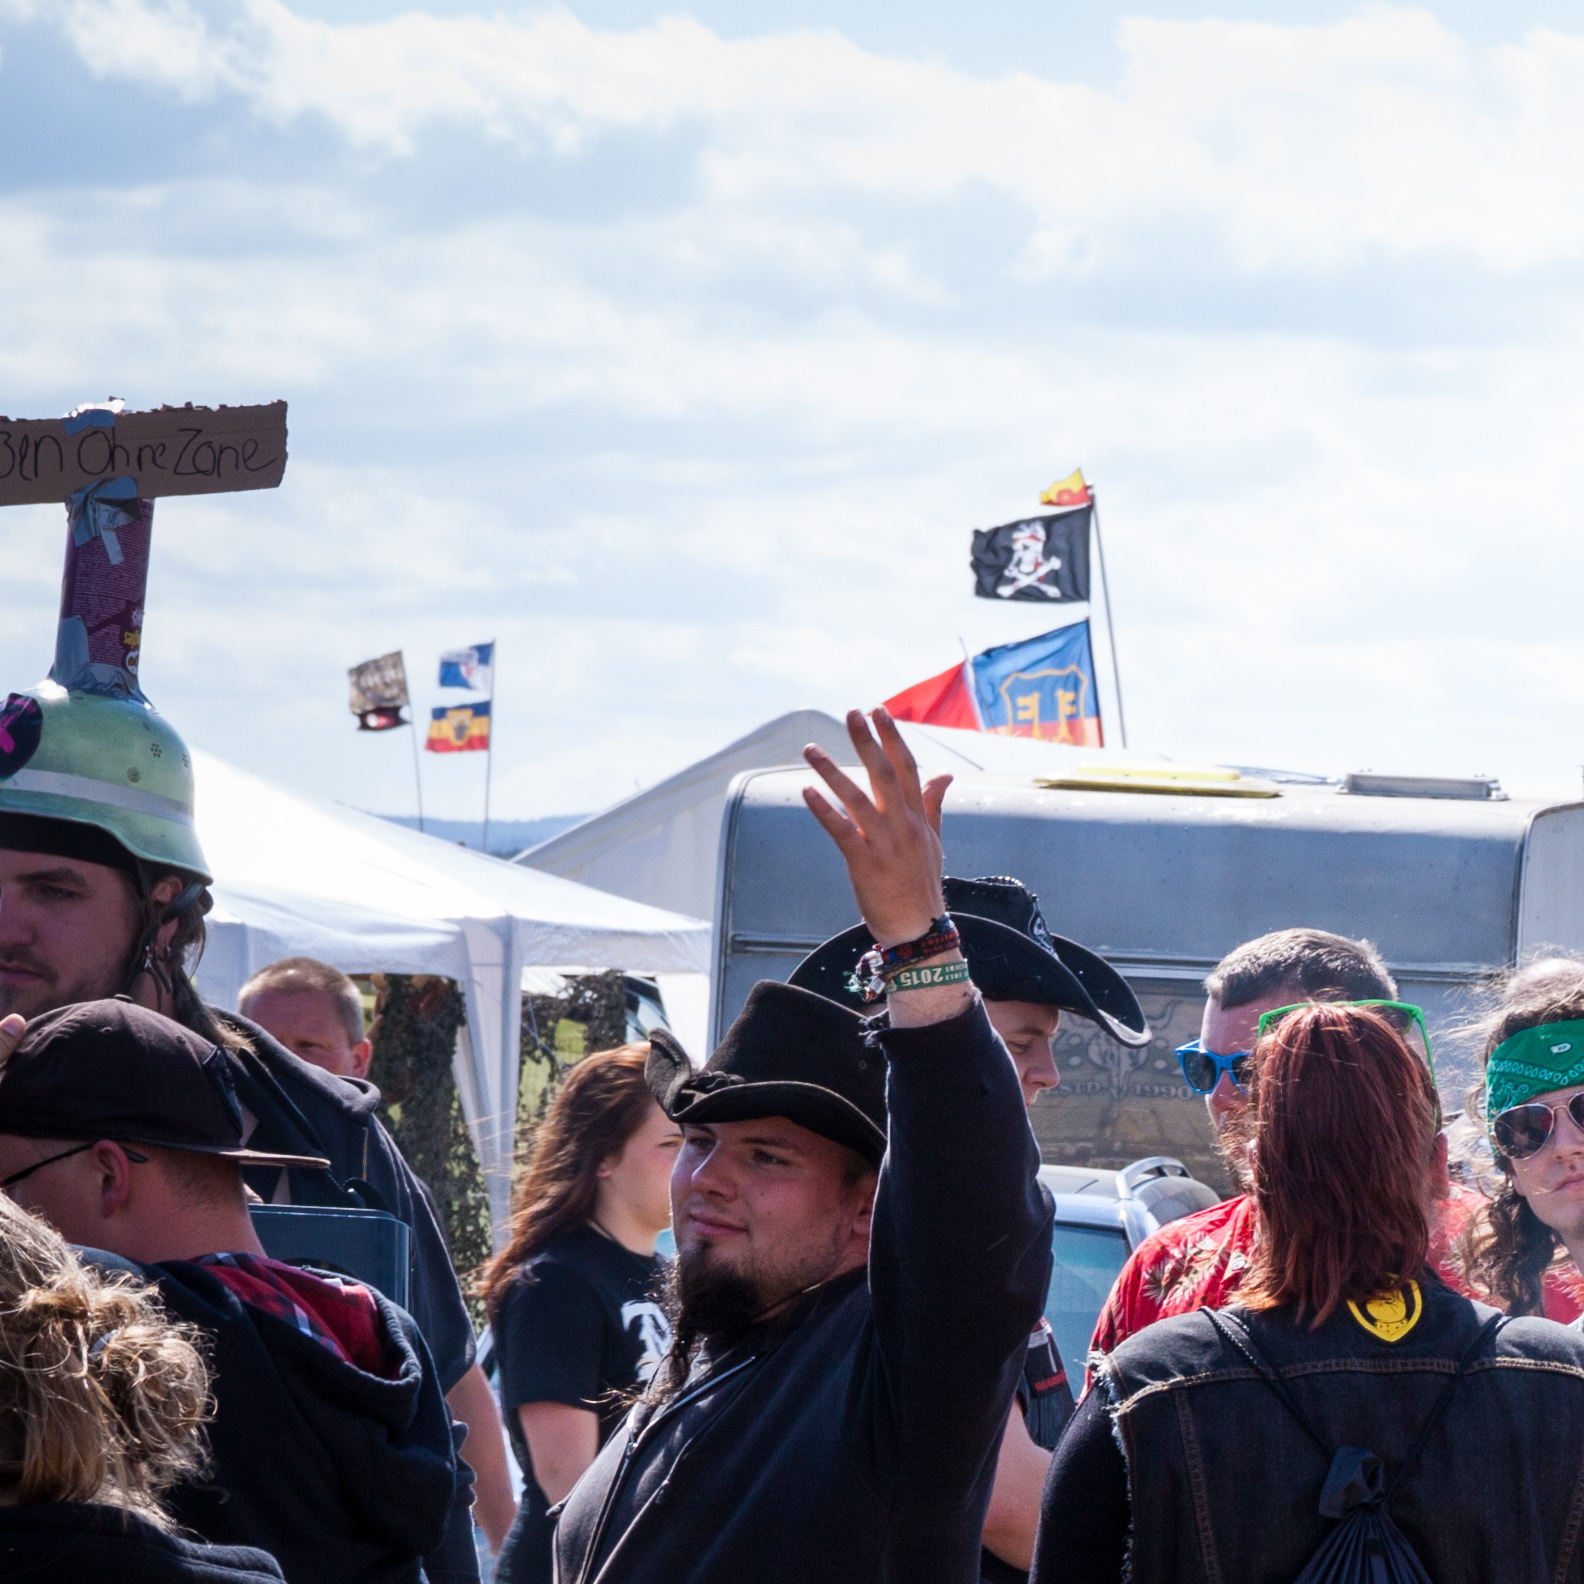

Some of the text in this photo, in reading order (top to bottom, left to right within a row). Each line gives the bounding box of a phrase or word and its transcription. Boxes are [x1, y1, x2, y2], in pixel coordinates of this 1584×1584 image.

[175, 428, 279, 478] Zone
[901, 967, 944, 988] 2015
[1136, 1082, 1193, 1100] 1990
